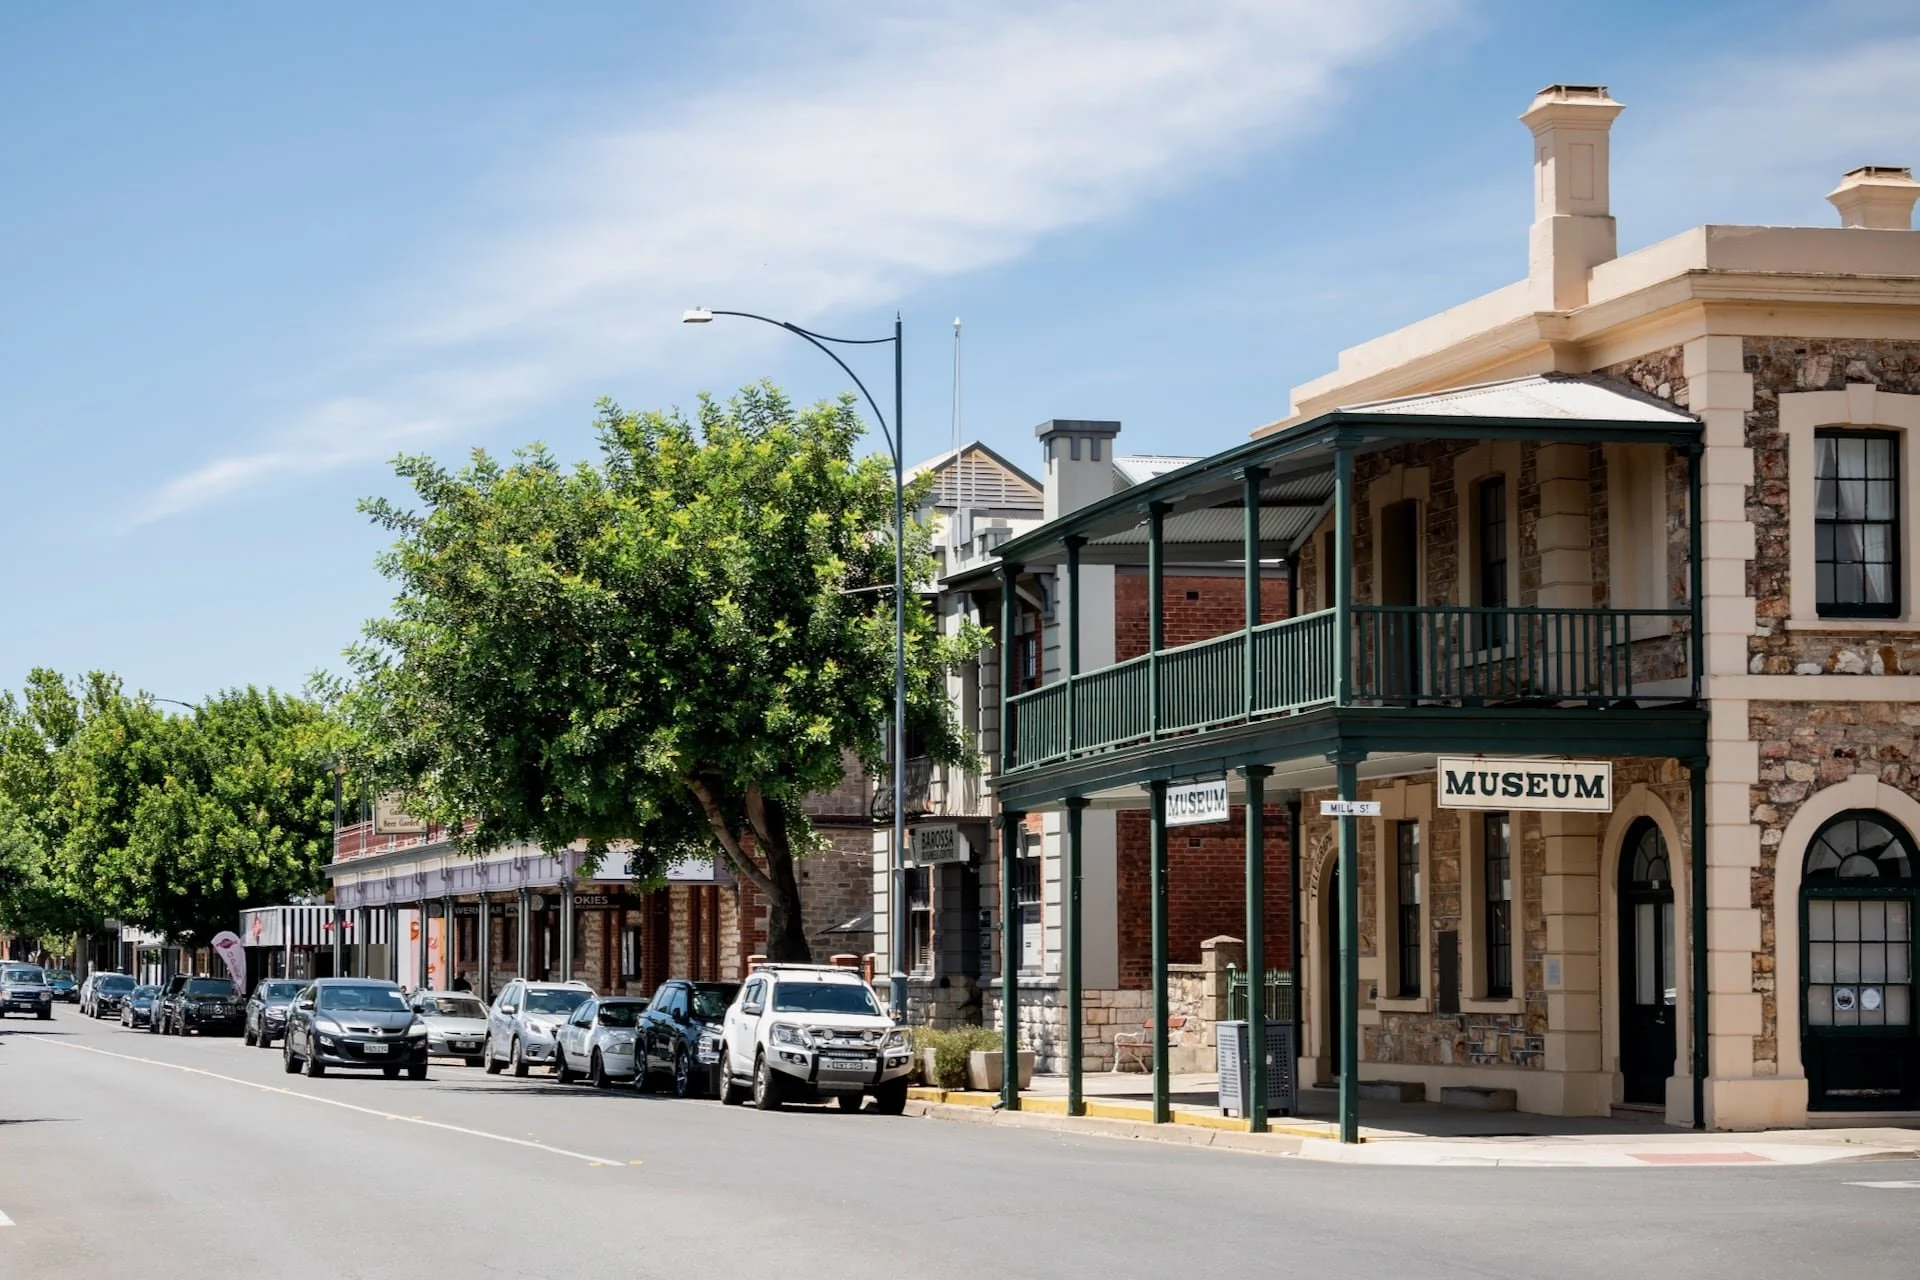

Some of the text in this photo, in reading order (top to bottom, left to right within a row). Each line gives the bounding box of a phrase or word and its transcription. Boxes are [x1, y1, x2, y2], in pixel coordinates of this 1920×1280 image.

[1446, 770, 1605, 799] MUSEUM
[1168, 788, 1225, 817] MUSEUM
[1330, 803, 1354, 813] MILL
[921, 829, 954, 850] BAROSSA
[574, 895, 609, 905] OKIES
[489, 906, 503, 914] AR
